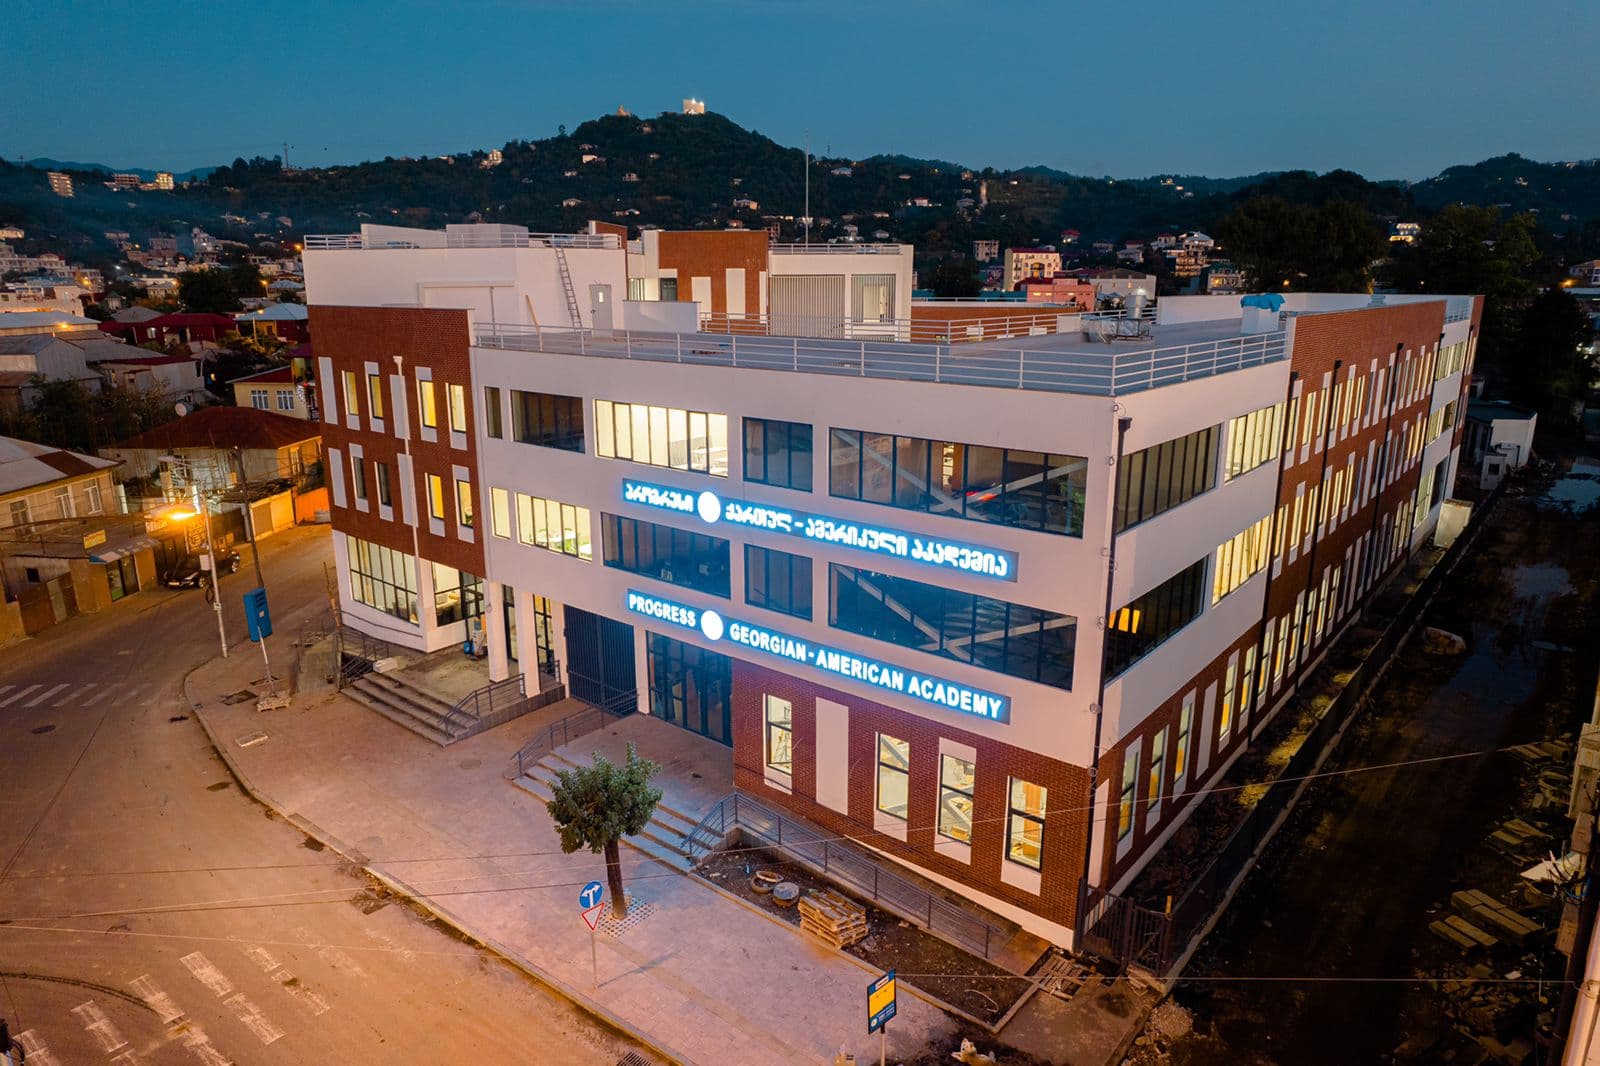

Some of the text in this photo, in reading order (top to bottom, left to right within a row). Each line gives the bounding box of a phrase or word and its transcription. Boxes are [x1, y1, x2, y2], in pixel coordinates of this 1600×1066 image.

[725, 503, 793, 532] ქართულ
[805, 518, 908, 556] ამერიკული
[911, 539, 1008, 576] აკადემია
[629, 594, 696, 627] PROGRESS
[729, 622, 806, 662] GEORGIAN
[815, 649, 904, 691] AMERICAN
[908, 676, 1002, 718] ACADEMY
